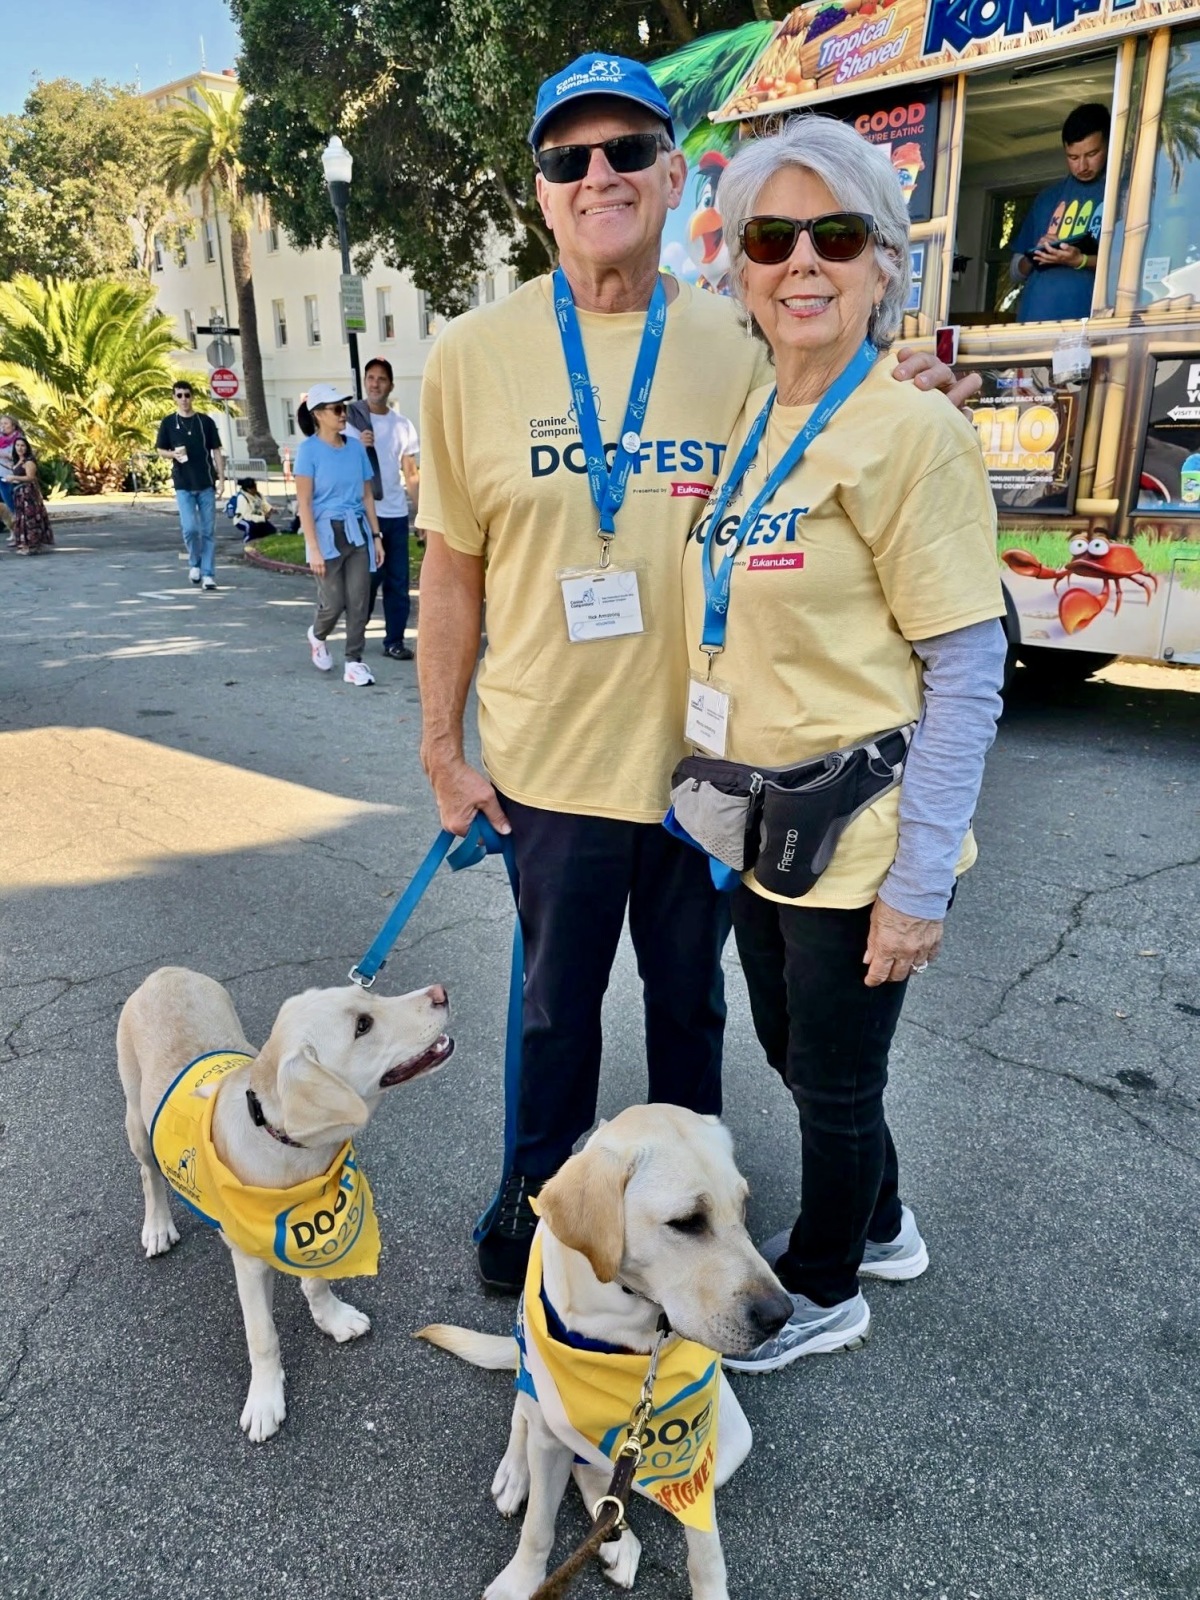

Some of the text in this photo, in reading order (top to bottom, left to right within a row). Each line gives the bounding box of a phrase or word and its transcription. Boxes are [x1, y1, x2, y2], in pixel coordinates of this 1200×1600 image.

[819, 8, 896, 67] Tropical
[836, 27, 909, 83] Shaved
[556, 73, 589, 90] Canine
[556, 75, 619, 96] Companions
[855, 103, 926, 134] GOOD
[890, 125, 925, 140] EATING
[529, 416, 567, 428] Canine
[530, 425, 580, 438] Compani
[677, 485, 711, 496] Eukanub
[751, 557, 797, 568] Eukanuba
[777, 828, 799, 872] FREETOO
[302, 1206, 360, 1262] 2025
